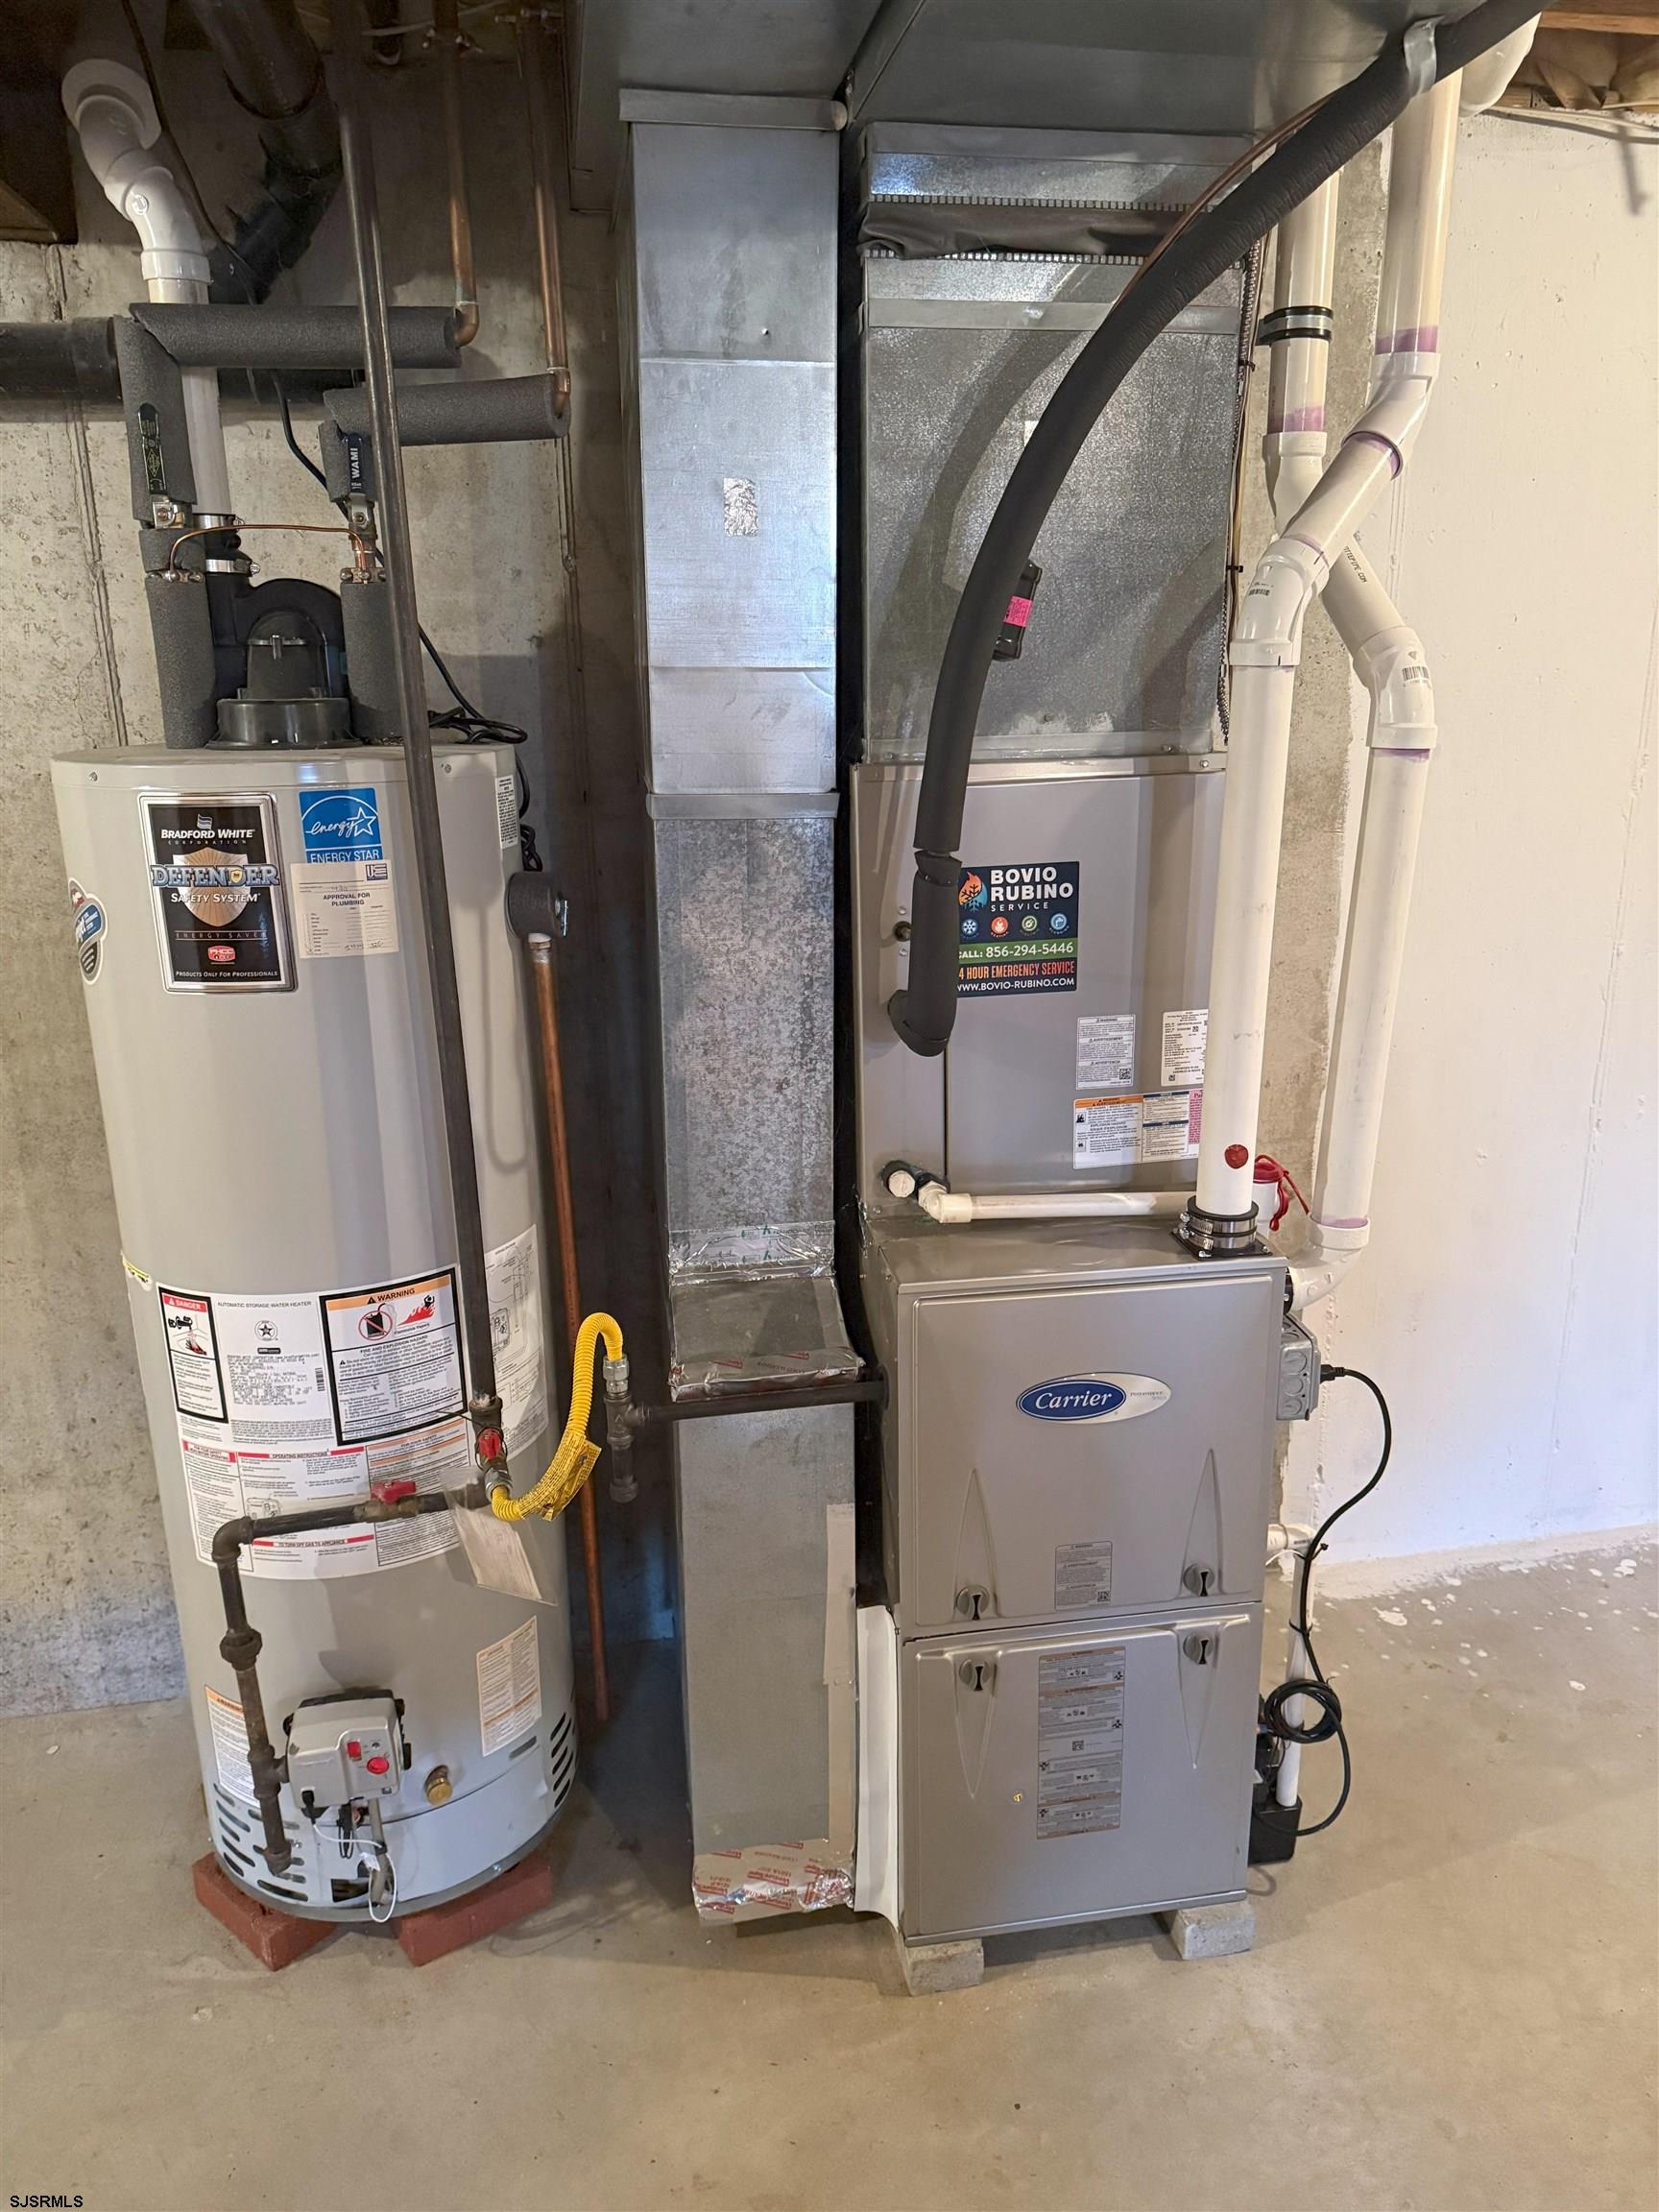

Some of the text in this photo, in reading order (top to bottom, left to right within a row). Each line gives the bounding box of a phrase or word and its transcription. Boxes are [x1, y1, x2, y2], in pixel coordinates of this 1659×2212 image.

[349, 447, 360, 479] WAMI
[160, 829, 253, 839] BRADFORD WHITE
[310, 849, 380, 864] ENERGY STAR
[152, 865, 279, 887] DEFENDER
[991, 867, 1057, 884] BOVIO
[171, 893, 258, 902] SAFETY SYSTEM
[991, 882, 1073, 902] RUBINO
[991, 902, 1049, 912] SERVICE
[986, 942, 1073, 958] 856-294-5446
[966, 966, 989, 979] HOUR
[991, 963, 1040, 978] EMERGENCY
[1042, 961, 1075, 975] SERVICE
[377, 1287, 416, 1302] WARNING
[1035, 1390, 1112, 1410] Carrier
